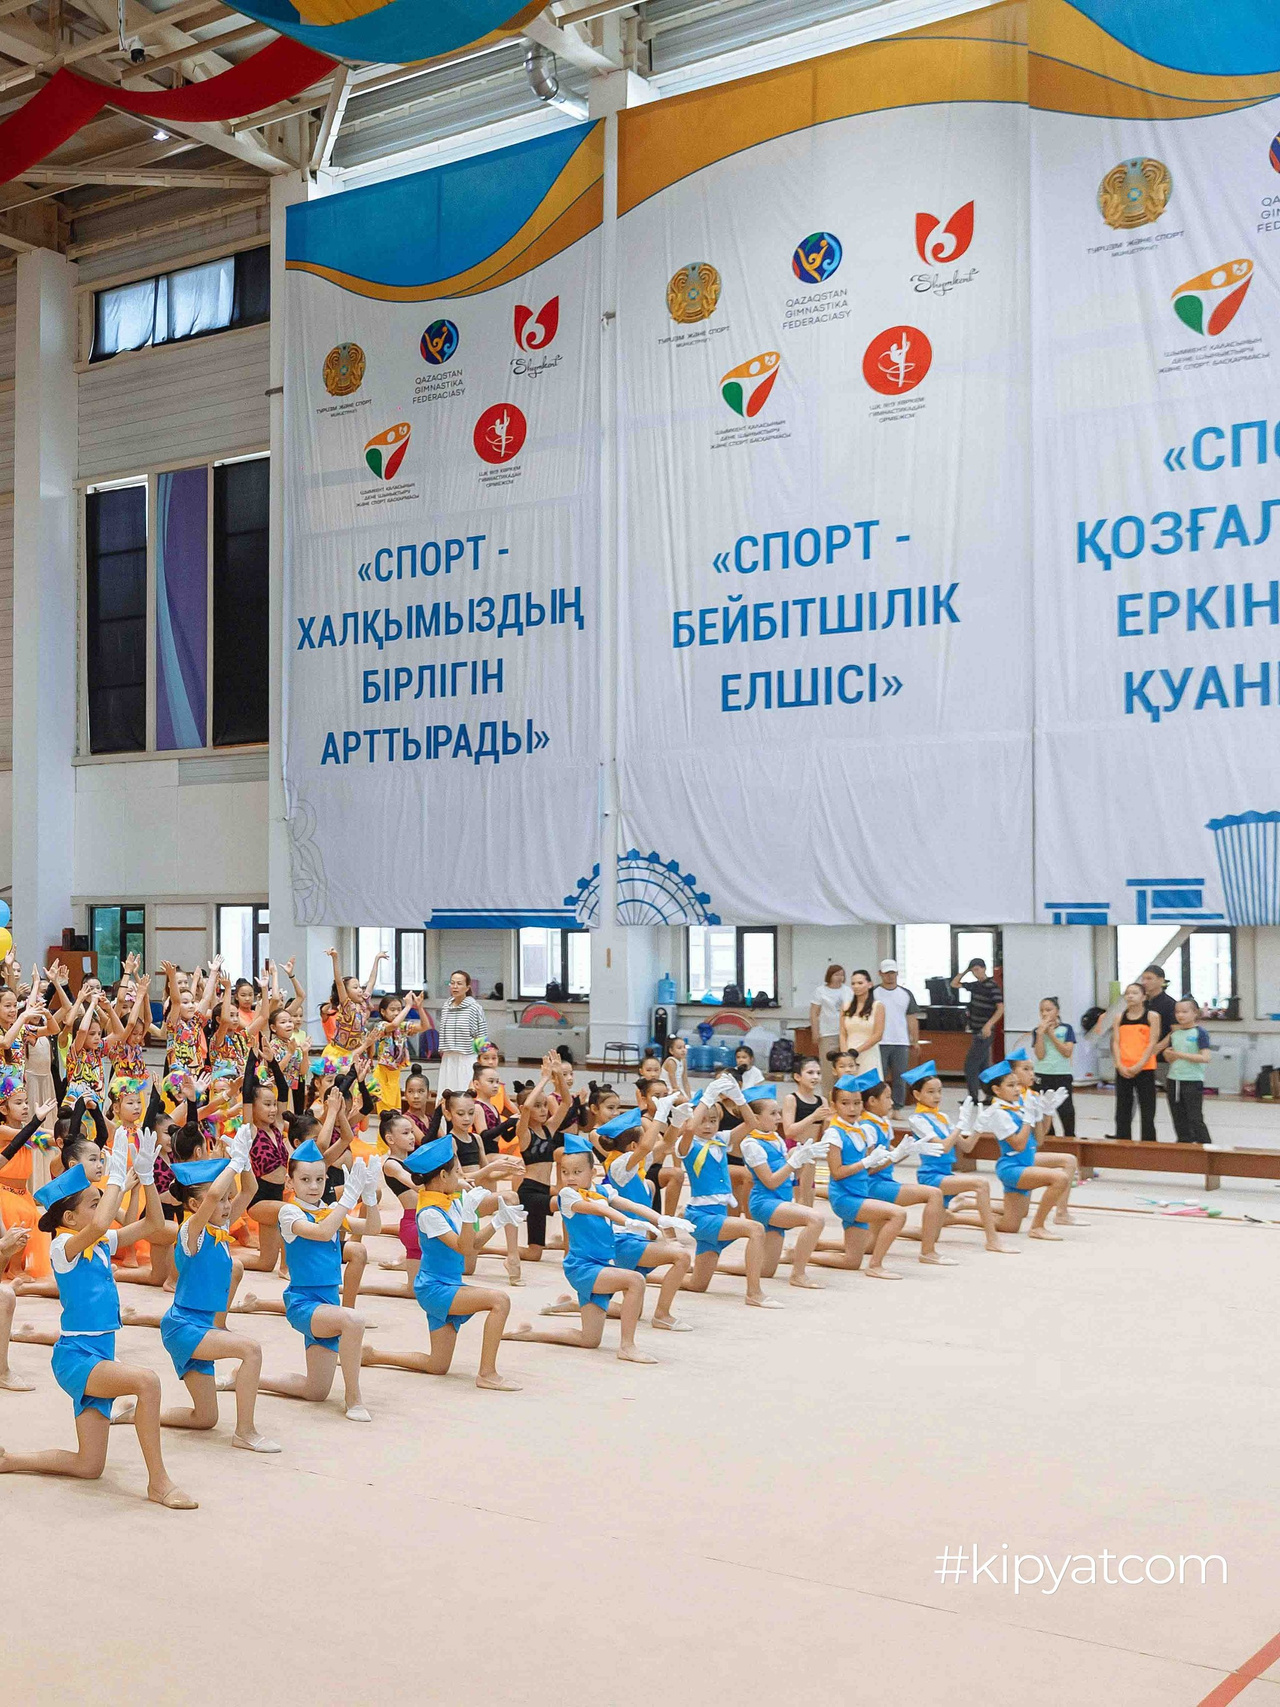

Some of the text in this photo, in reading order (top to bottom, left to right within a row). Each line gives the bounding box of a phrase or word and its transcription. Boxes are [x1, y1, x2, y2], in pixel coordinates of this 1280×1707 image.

[782, 310, 852, 330] FEDERACIASY
[785, 288, 848, 308] QAZAQSTAN
[785, 300, 849, 319] GIMNASTIKA
[412, 388, 466, 404] FEDERACIASY
[414, 379, 463, 394] GIMNASTIKA
[415, 369, 463, 385] QAZAQSTAN
[1163, 420, 1280, 472] «СП
[358, 535, 486, 582] «СПОРТ
[712, 519, 880, 574] «СПОРТ
[297, 586, 585, 650] ХАЛҚЫМЫЗДЫҢ
[672, 583, 961, 648] БЕЙБІТШІЛІК
[1117, 580, 1279, 637] ЕРКІН
[362, 658, 504, 704] БІРЛІГІН
[721, 663, 903, 712] ЕЛШІСІ»
[1124, 661, 1280, 723] ҚУАН
[320, 719, 550, 766] АРТТЫРАДЫ»
